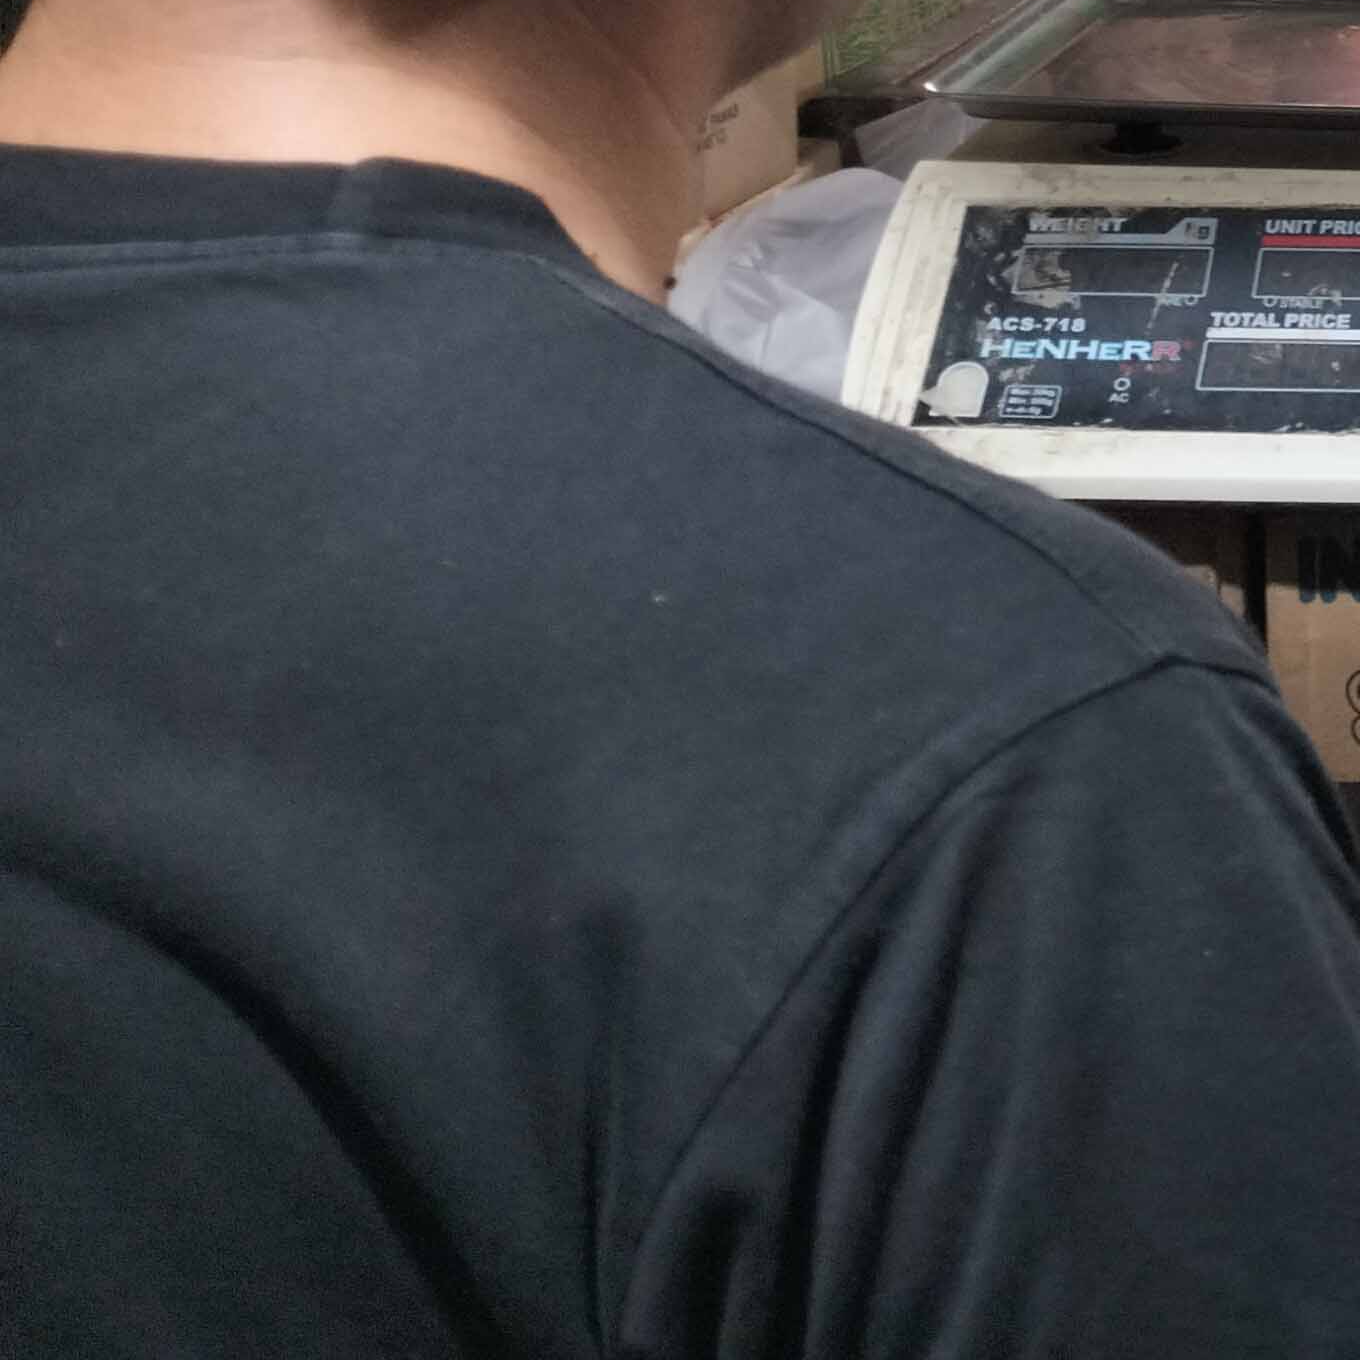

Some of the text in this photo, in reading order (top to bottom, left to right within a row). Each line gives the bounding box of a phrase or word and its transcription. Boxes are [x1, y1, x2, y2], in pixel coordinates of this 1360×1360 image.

[1265, 219, 1316, 234] UNIT
[986, 316, 1087, 333] ACS-718
[1210, 311, 1281, 328] TOTAL
[1284, 312, 1352, 329] PRICE
